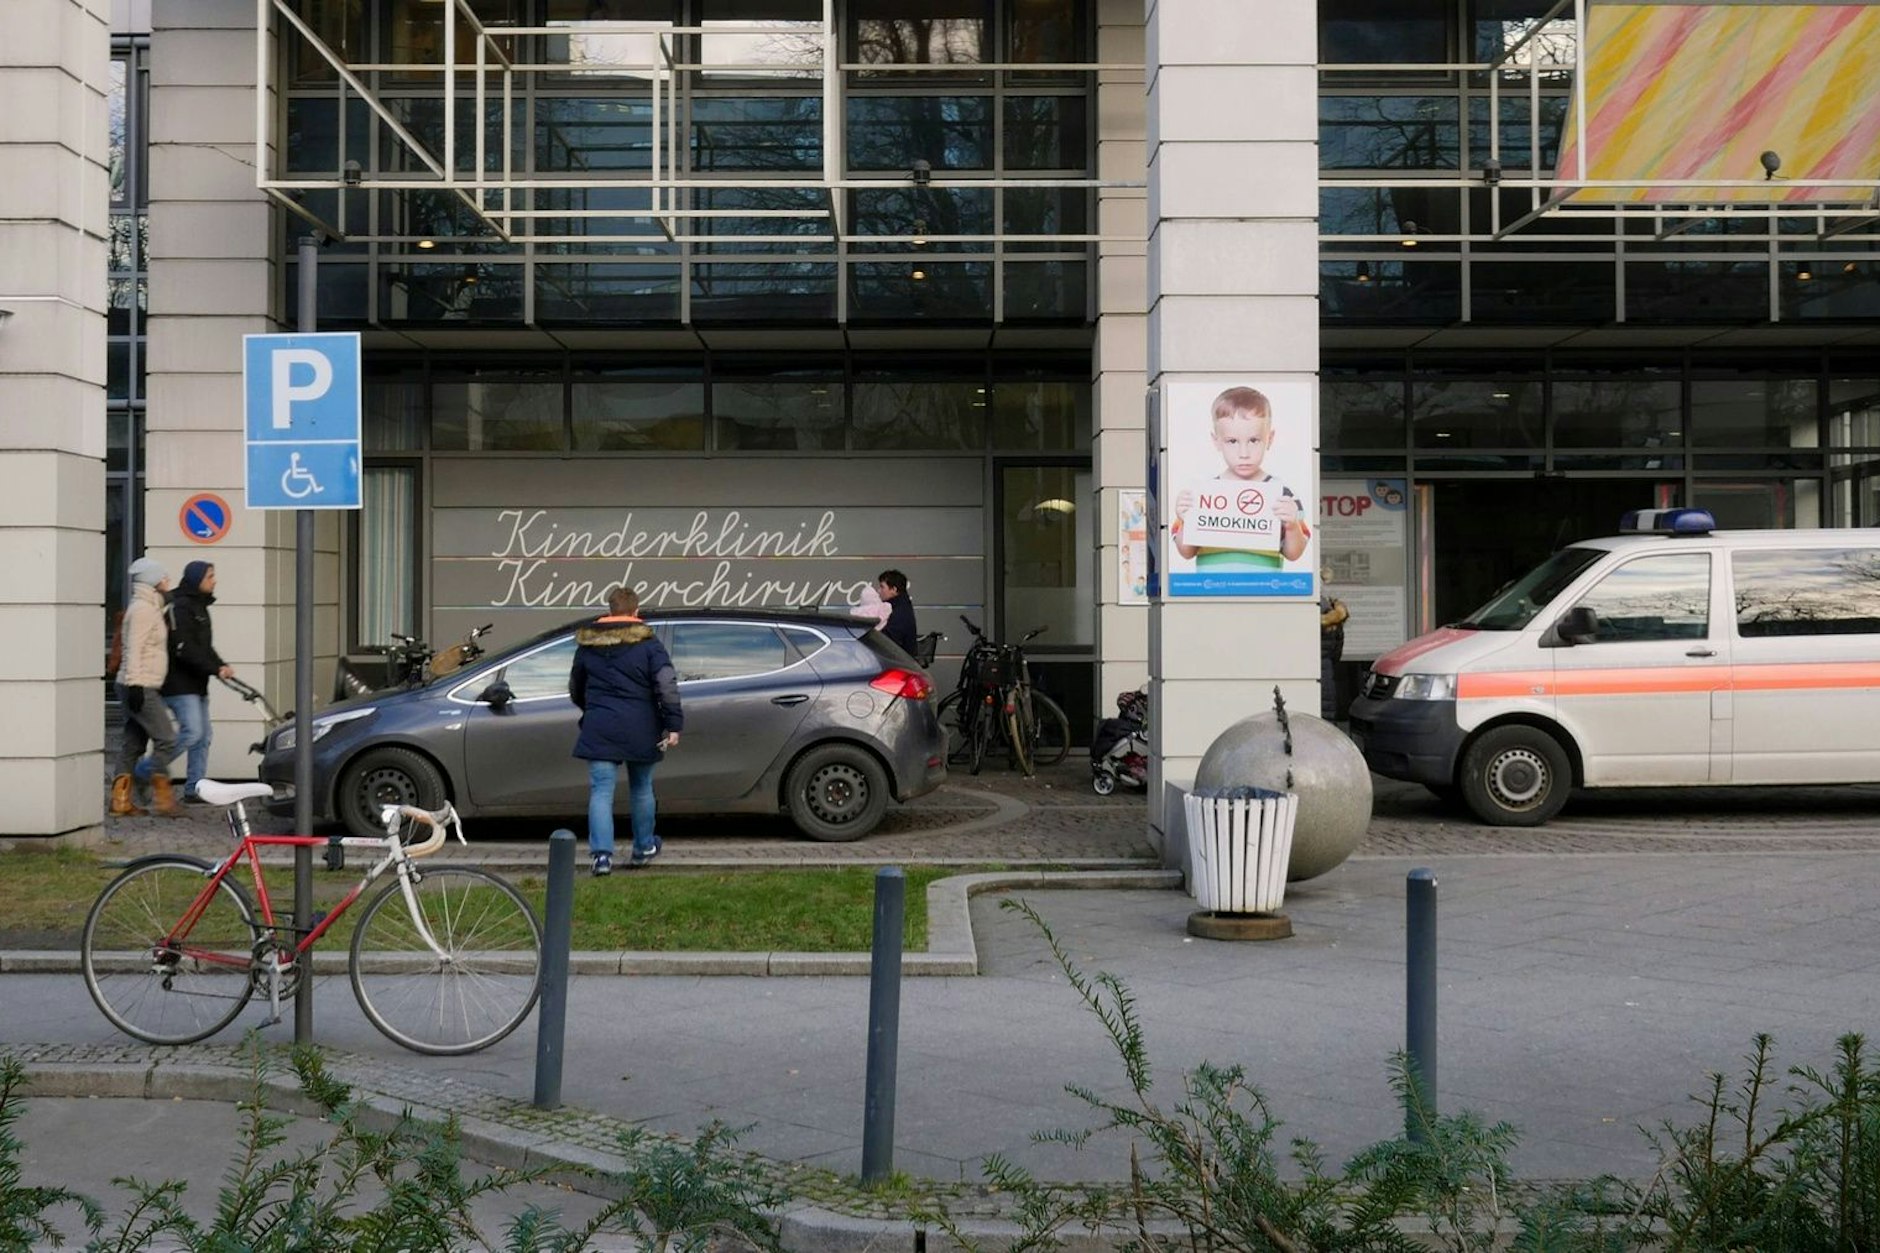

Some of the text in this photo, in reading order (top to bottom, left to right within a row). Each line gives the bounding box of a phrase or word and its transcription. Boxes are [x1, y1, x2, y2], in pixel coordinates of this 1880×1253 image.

[271, 348, 333, 429] P
[1199, 494, 1228, 510] NO
[1320, 495, 1372, 517] TOP
[492, 510, 839, 557] Kinderklinik
[1197, 515, 1273, 531] SMOKING!
